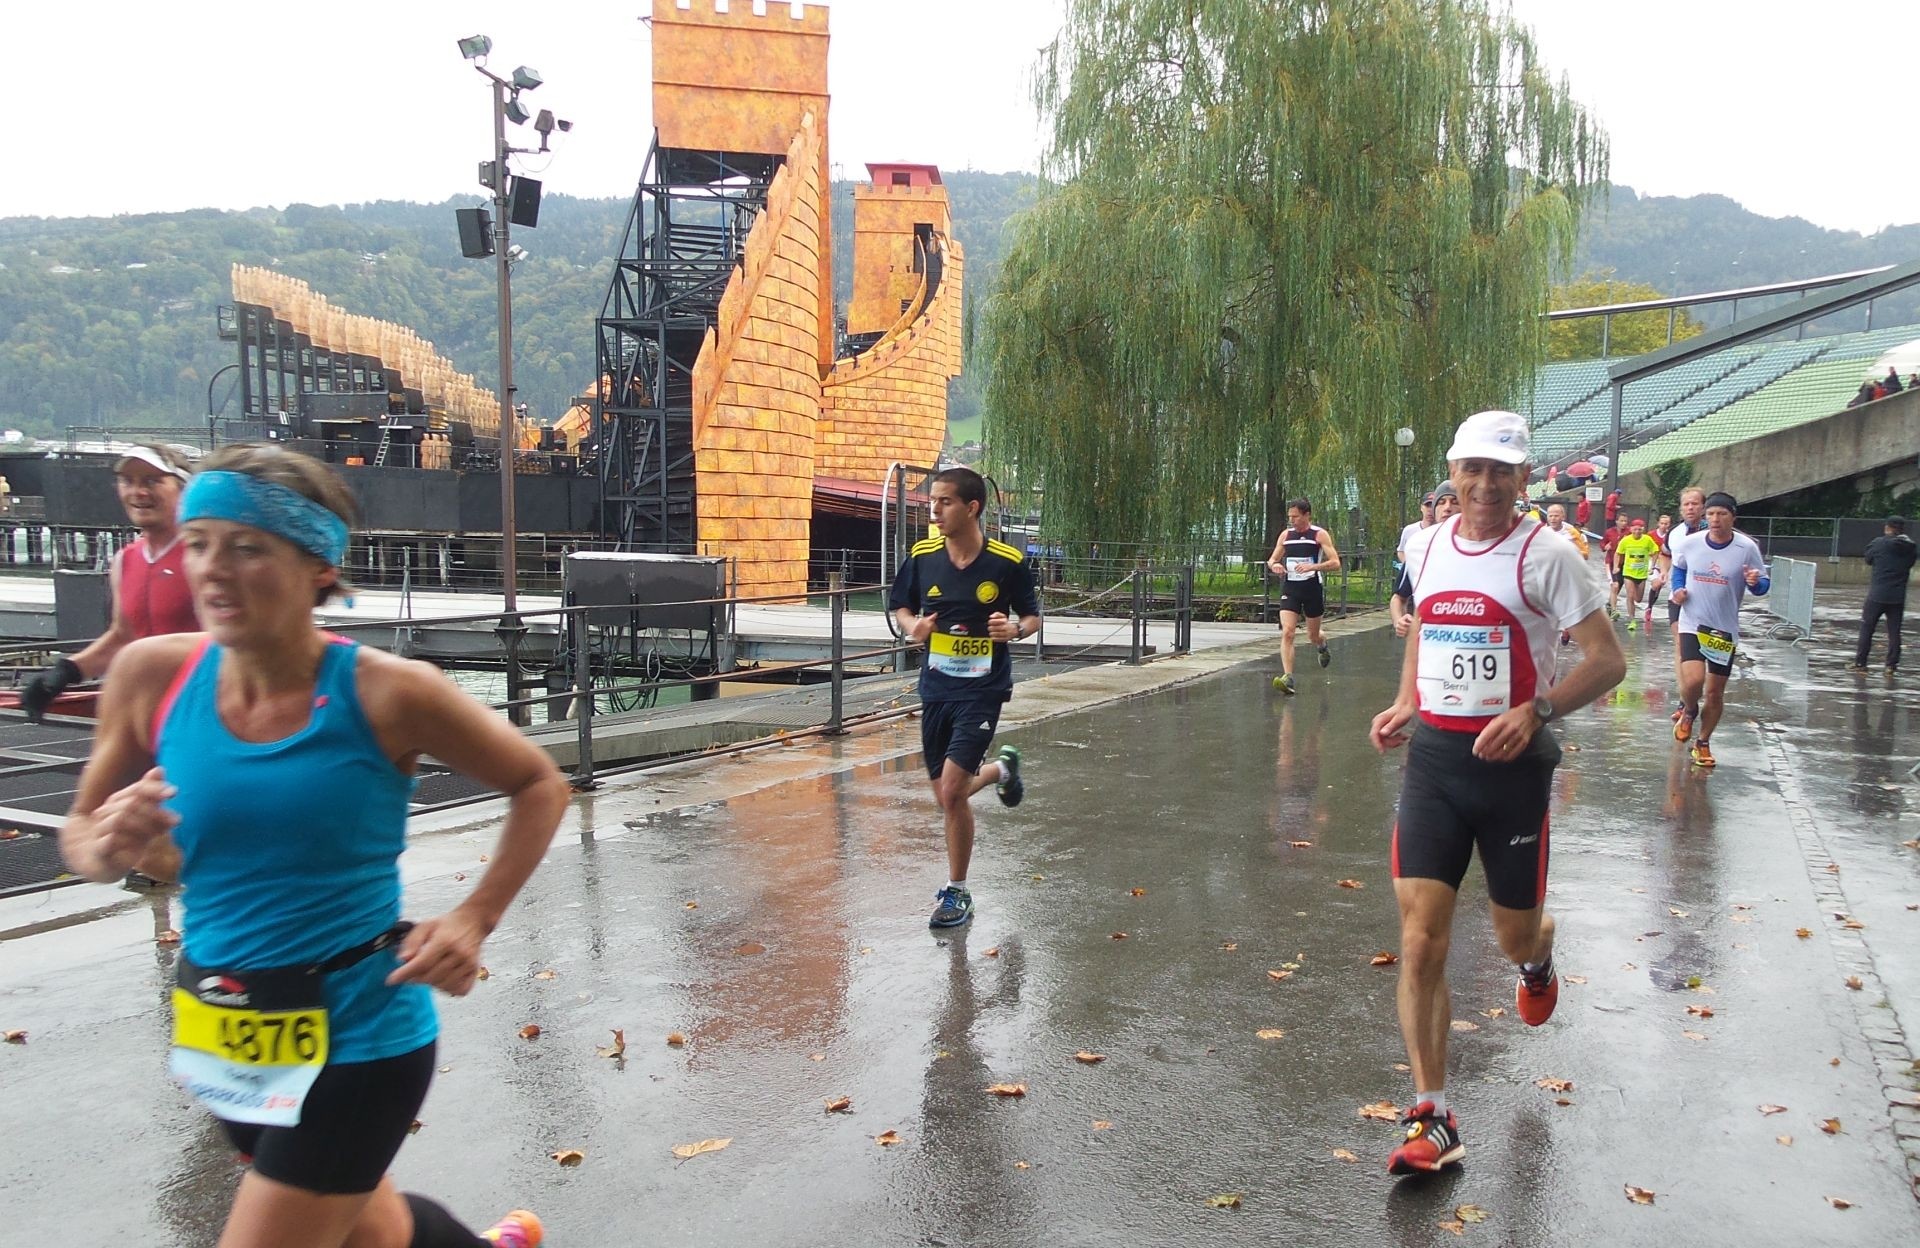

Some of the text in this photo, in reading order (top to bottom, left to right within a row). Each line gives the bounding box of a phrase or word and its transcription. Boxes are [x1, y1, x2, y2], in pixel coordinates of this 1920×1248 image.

[1432, 602, 1485, 616] GRAVAG
[1423, 629, 1487, 643] SPARKASSE
[952, 639, 989, 655] 4656
[1707, 638, 1733, 652] 6086
[1452, 654, 1497, 680] 619
[221, 1016, 318, 1062] 4876
